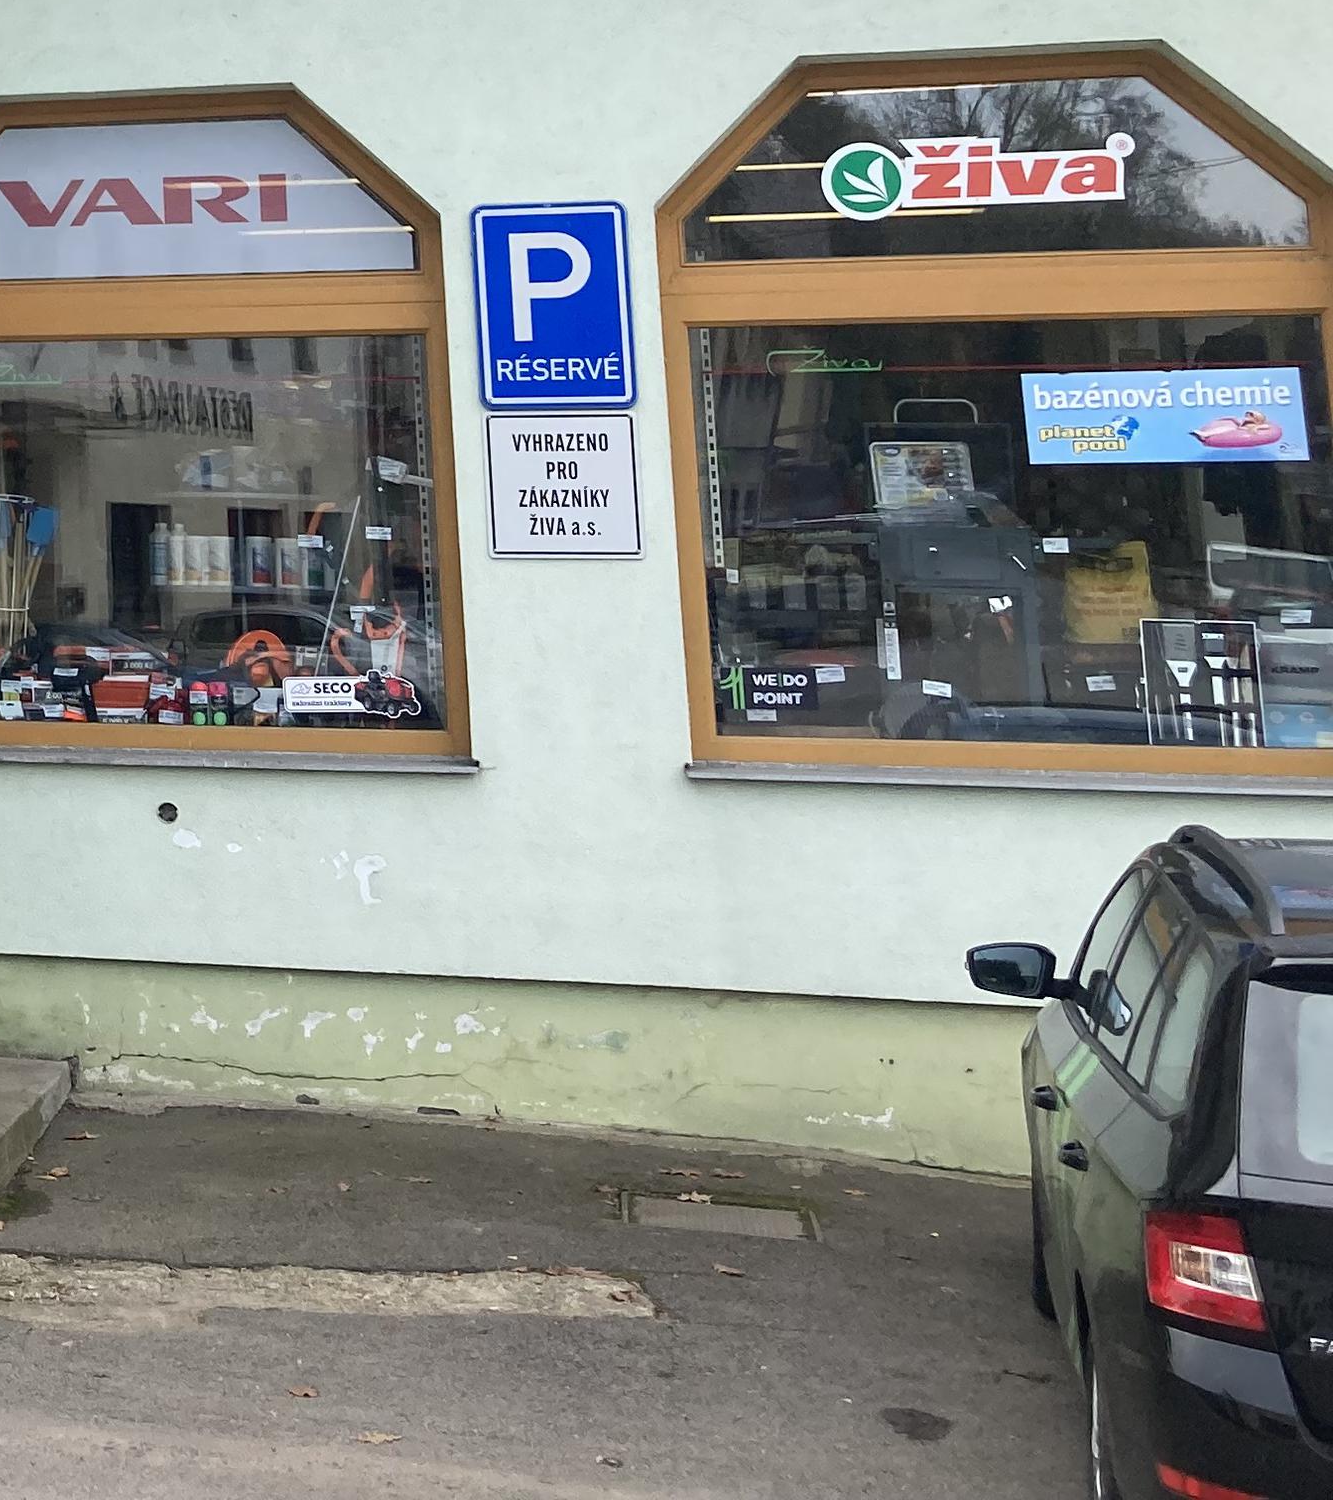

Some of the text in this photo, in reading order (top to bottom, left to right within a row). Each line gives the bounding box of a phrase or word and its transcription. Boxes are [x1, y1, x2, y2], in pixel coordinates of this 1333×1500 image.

[911, 144, 1117, 201] živa
[508, 231, 592, 342] P
[496, 352, 621, 382] RÉSERVÉ
[1033, 378, 1291, 409] bazénová chemie
[512, 433, 609, 452] VYHRAZENO
[1039, 425, 1115, 442] planet
[1072, 439, 1127, 455] pool
[546, 461, 578, 479] PRO
[518, 486, 610, 508] ZÁKAZNÍKY
[529, 514, 602, 536] ŽIVA a.s.
[313, 682, 351, 694] SECO
[753, 692, 803, 705] POINT
